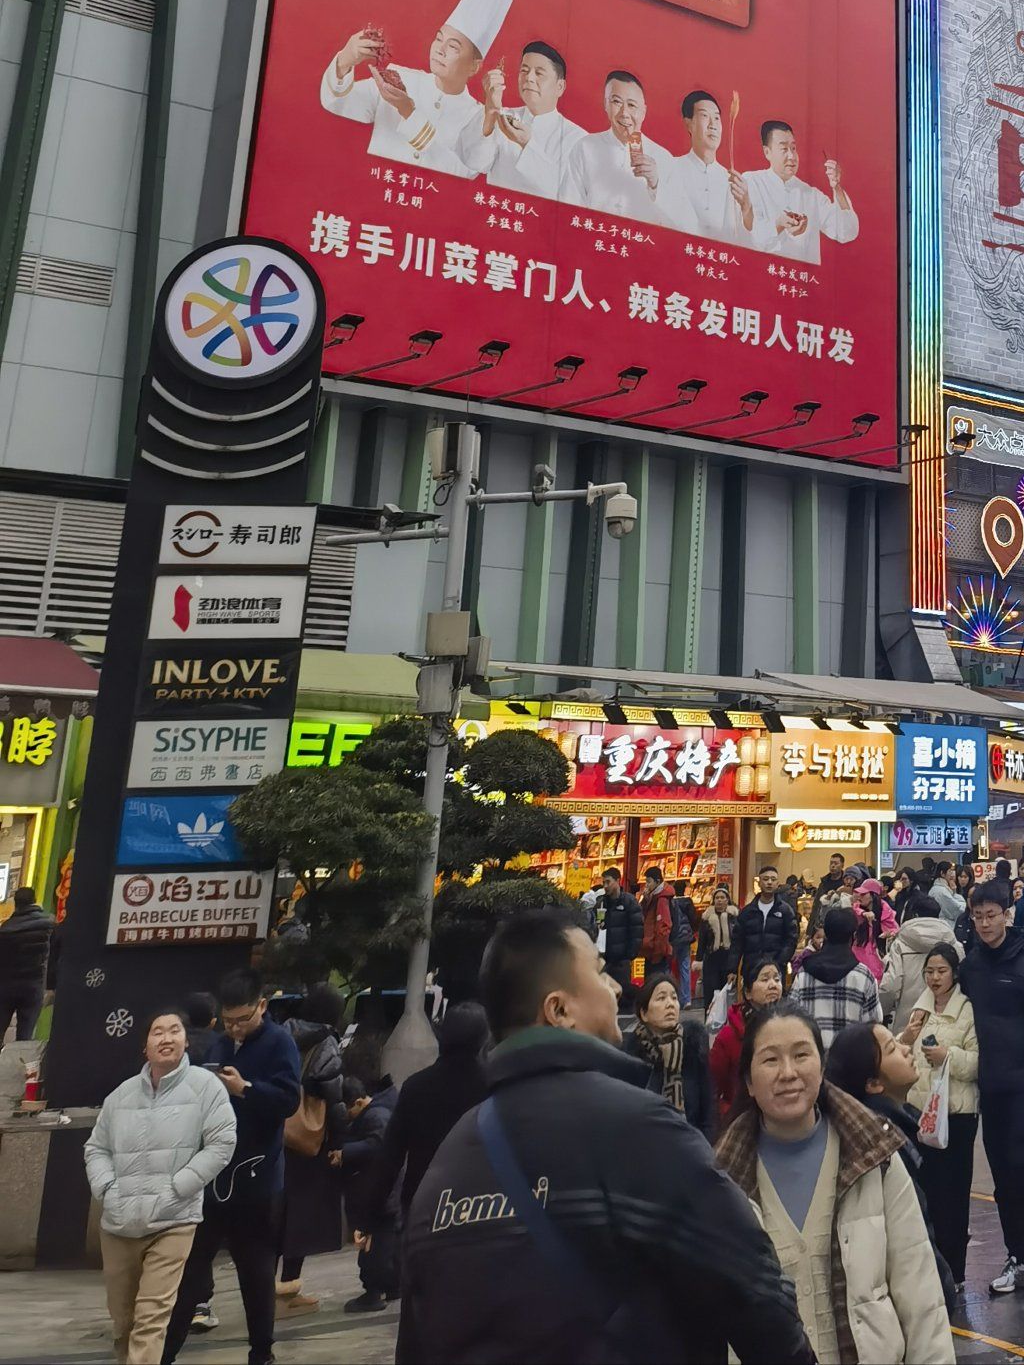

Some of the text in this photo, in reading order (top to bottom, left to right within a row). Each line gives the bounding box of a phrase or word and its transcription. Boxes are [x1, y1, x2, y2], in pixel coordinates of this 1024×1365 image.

[370, 166, 440, 194] 川菜掌门人
[383, 188, 423, 210] 肖见明
[473, 191, 540, 217] 辣条发明人
[569, 215, 656, 245] 麻辣王子创始人
[683, 243, 741, 266] 辣条发明人
[766, 263, 821, 285] 辣条发明人
[309, 210, 856, 366] 携手川菜掌门人、辣条发明人研发
[170, 523, 302, 546] スシロー 寿司郎
[197, 597, 283, 611] 劲浪体育
[603, 733, 742, 789] 重庆特产
[912, 736, 977, 771] 喜小摘
[912, 777, 976, 803] 分子果汁
[119, 906, 261, 925] BARBECUE BUFFET
